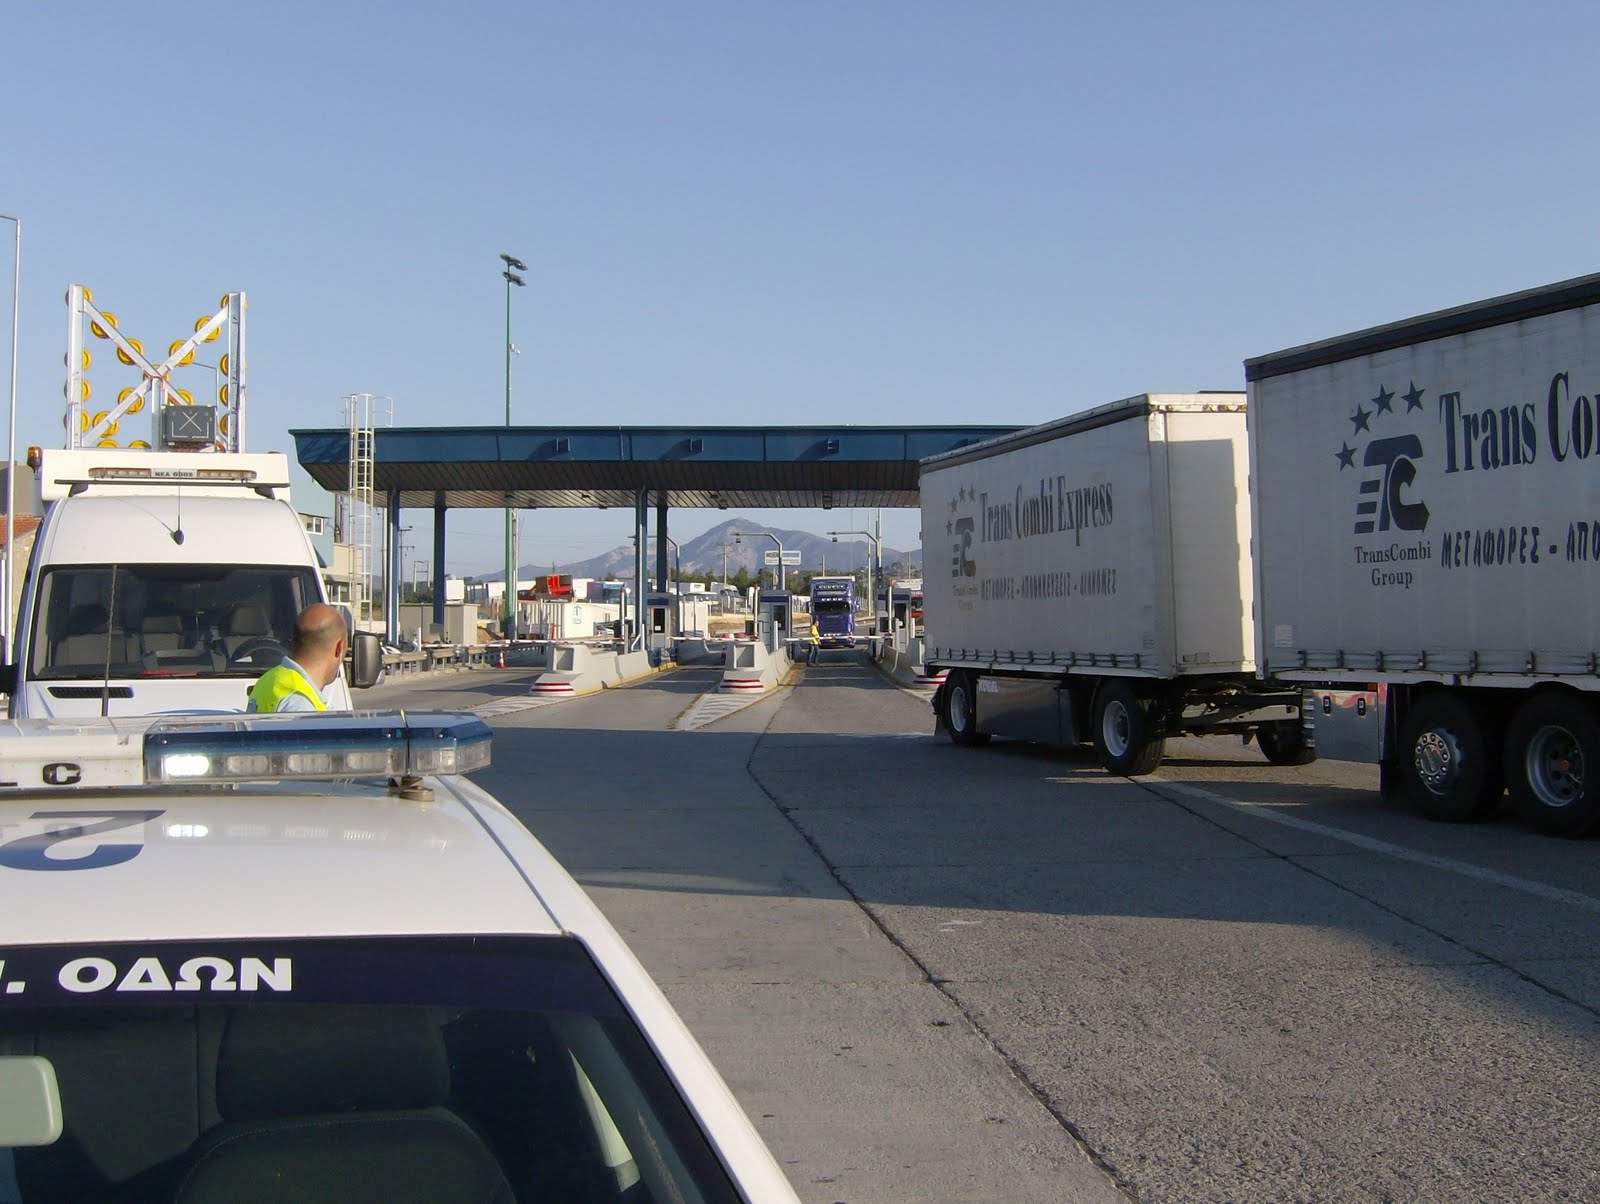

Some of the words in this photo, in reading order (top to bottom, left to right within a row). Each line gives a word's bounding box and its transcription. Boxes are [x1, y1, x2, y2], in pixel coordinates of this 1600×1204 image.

[1439, 391, 1537, 474] Trans
[1547, 370, 1600, 463] Co
[980, 492, 1013, 543] Trans
[1015, 476, 1054, 540] Combi
[1056, 475, 1114, 547] Express
[1354, 540, 1432, 564] TransCombi
[1440, 525, 1540, 569] ΜΕΤΑΦΟΡΕΣ
[1371, 568, 1413, 589] Group
[58, 956, 293, 993] ΟΔΩΝ
